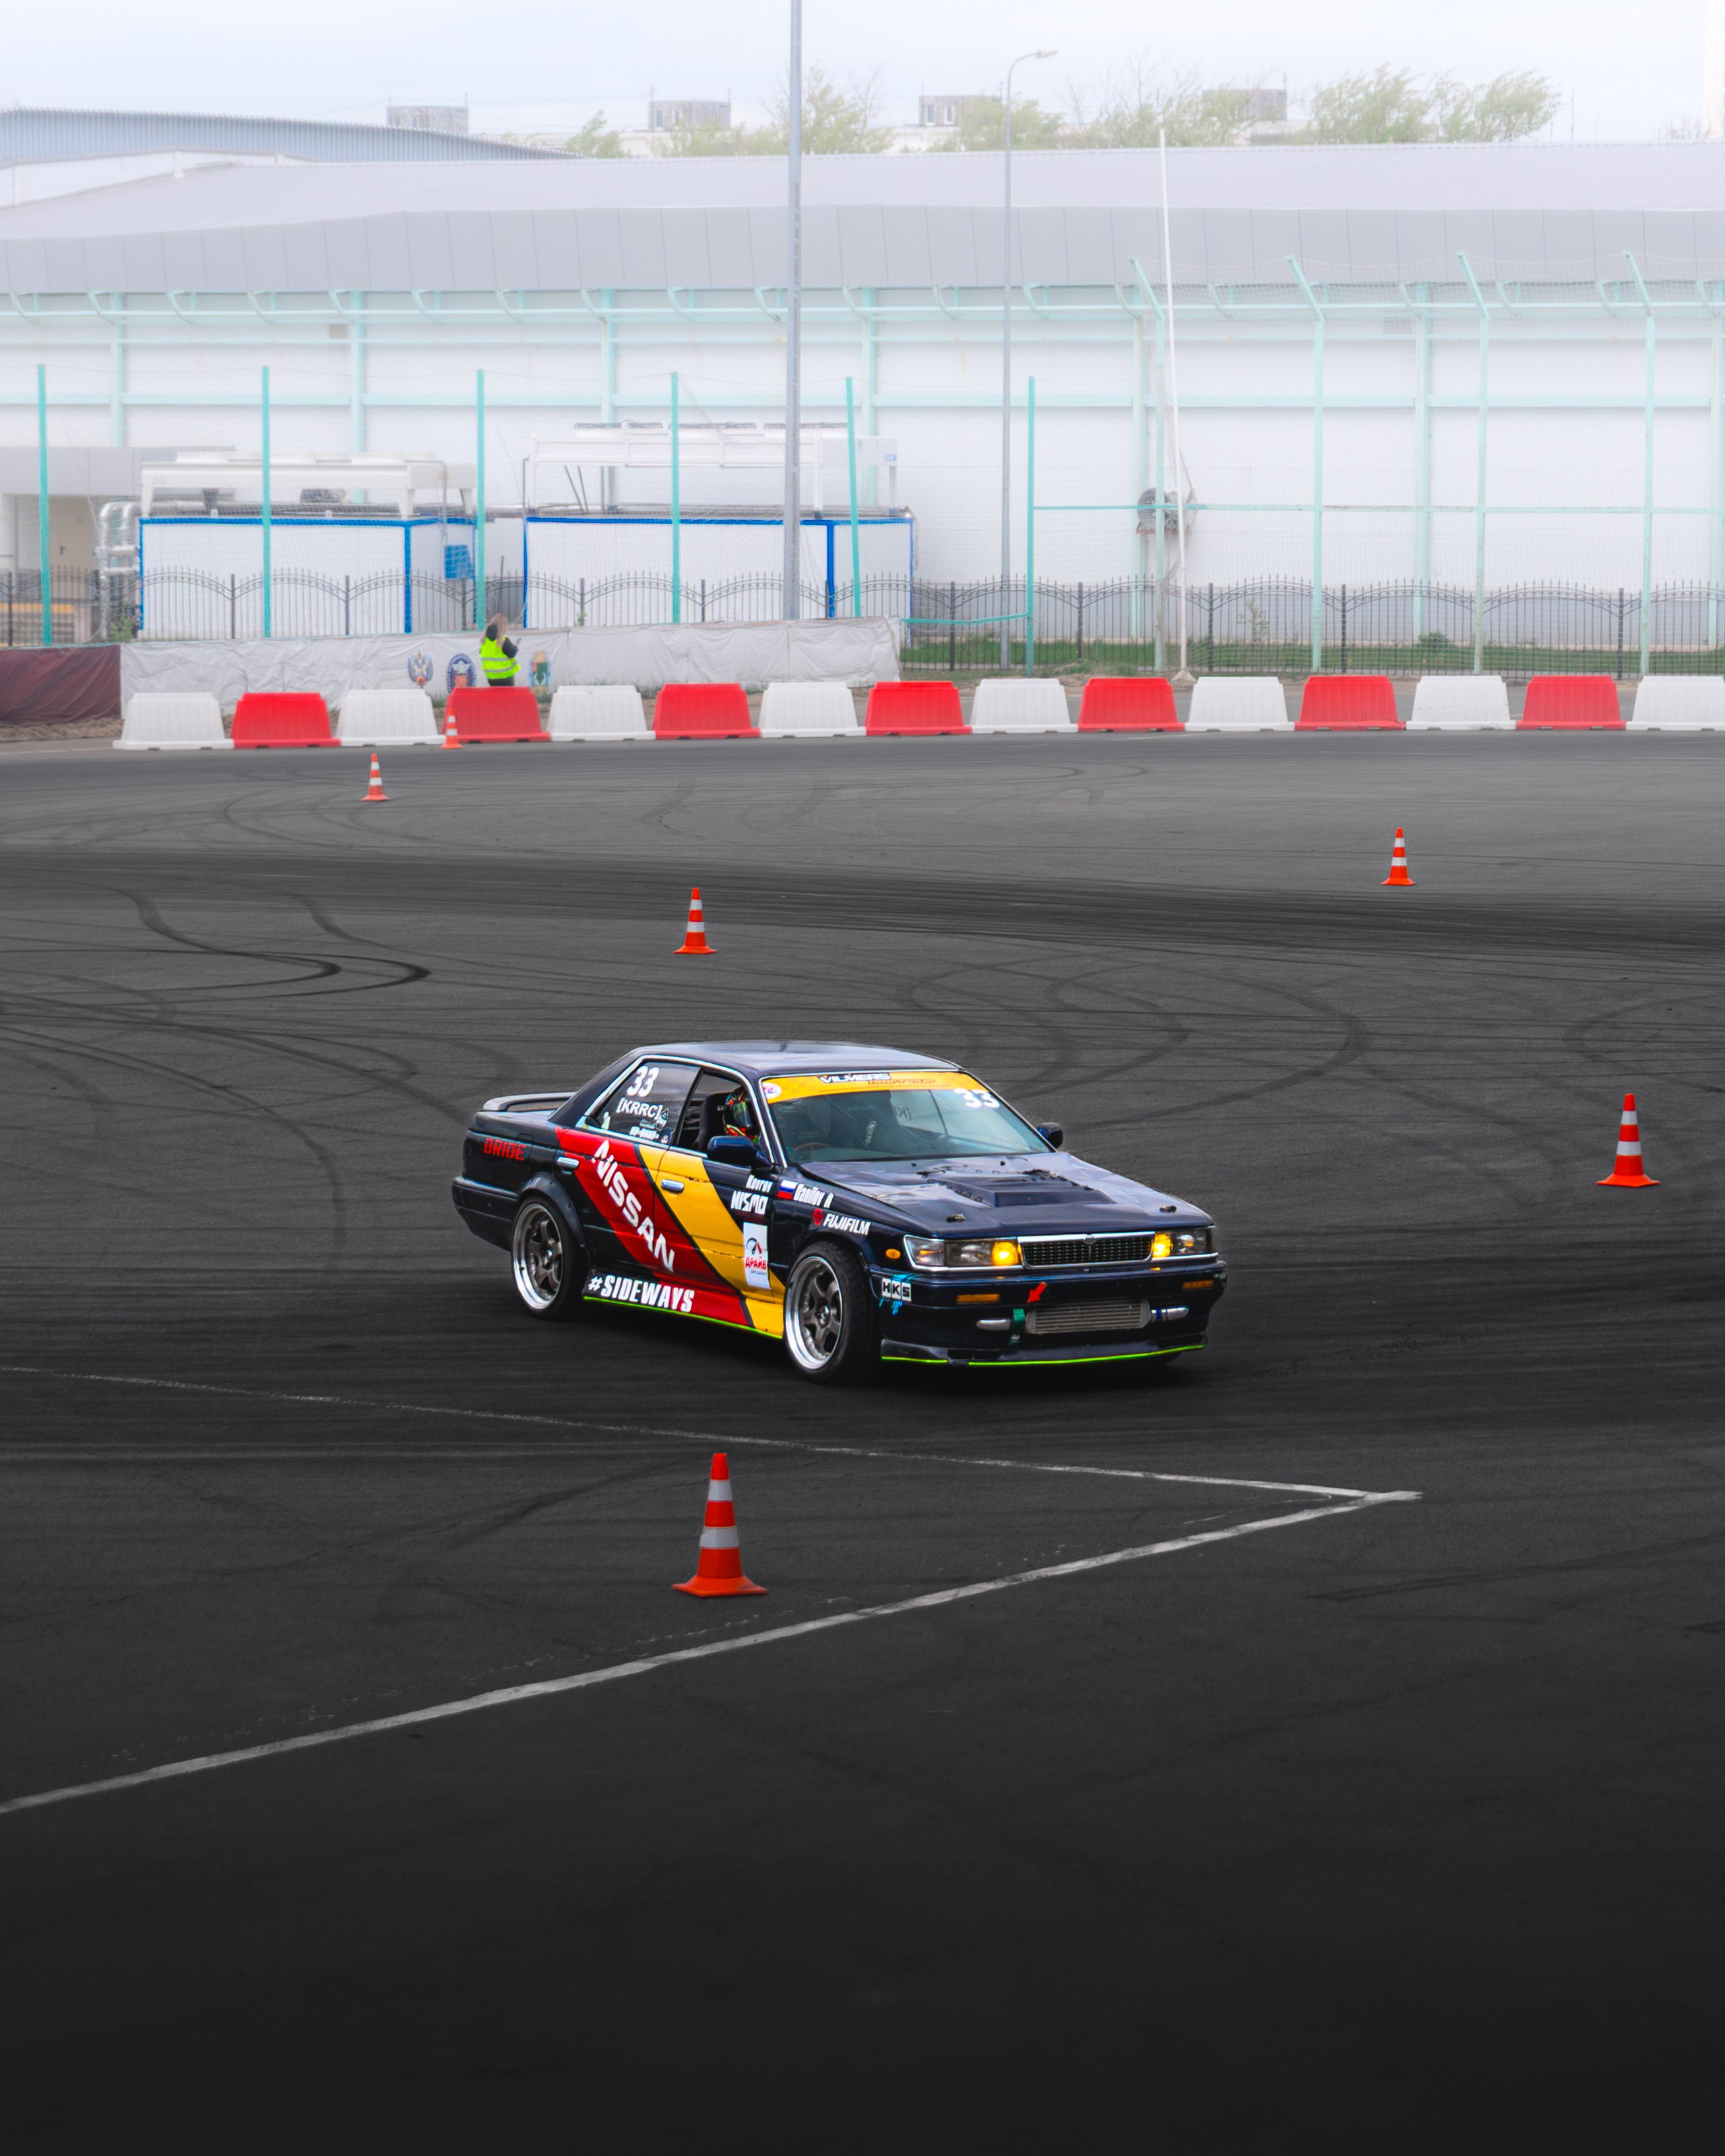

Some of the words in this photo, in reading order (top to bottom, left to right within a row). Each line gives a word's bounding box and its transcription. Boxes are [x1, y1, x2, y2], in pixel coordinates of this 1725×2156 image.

[627, 1065, 660, 1098] 33
[819, 1073, 891, 1084] VILMERS
[953, 1087, 1001, 1108] 33
[592, 1139, 675, 1273] NISSAN
[730, 1190, 769, 1215] NISMO
[823, 1213, 871, 1236] FUJIFILM
[745, 1257, 766, 1270] ДРАЙВ
[588, 1275, 695, 1312] #SIDEWAYS
[883, 1280, 910, 1298] HKS
